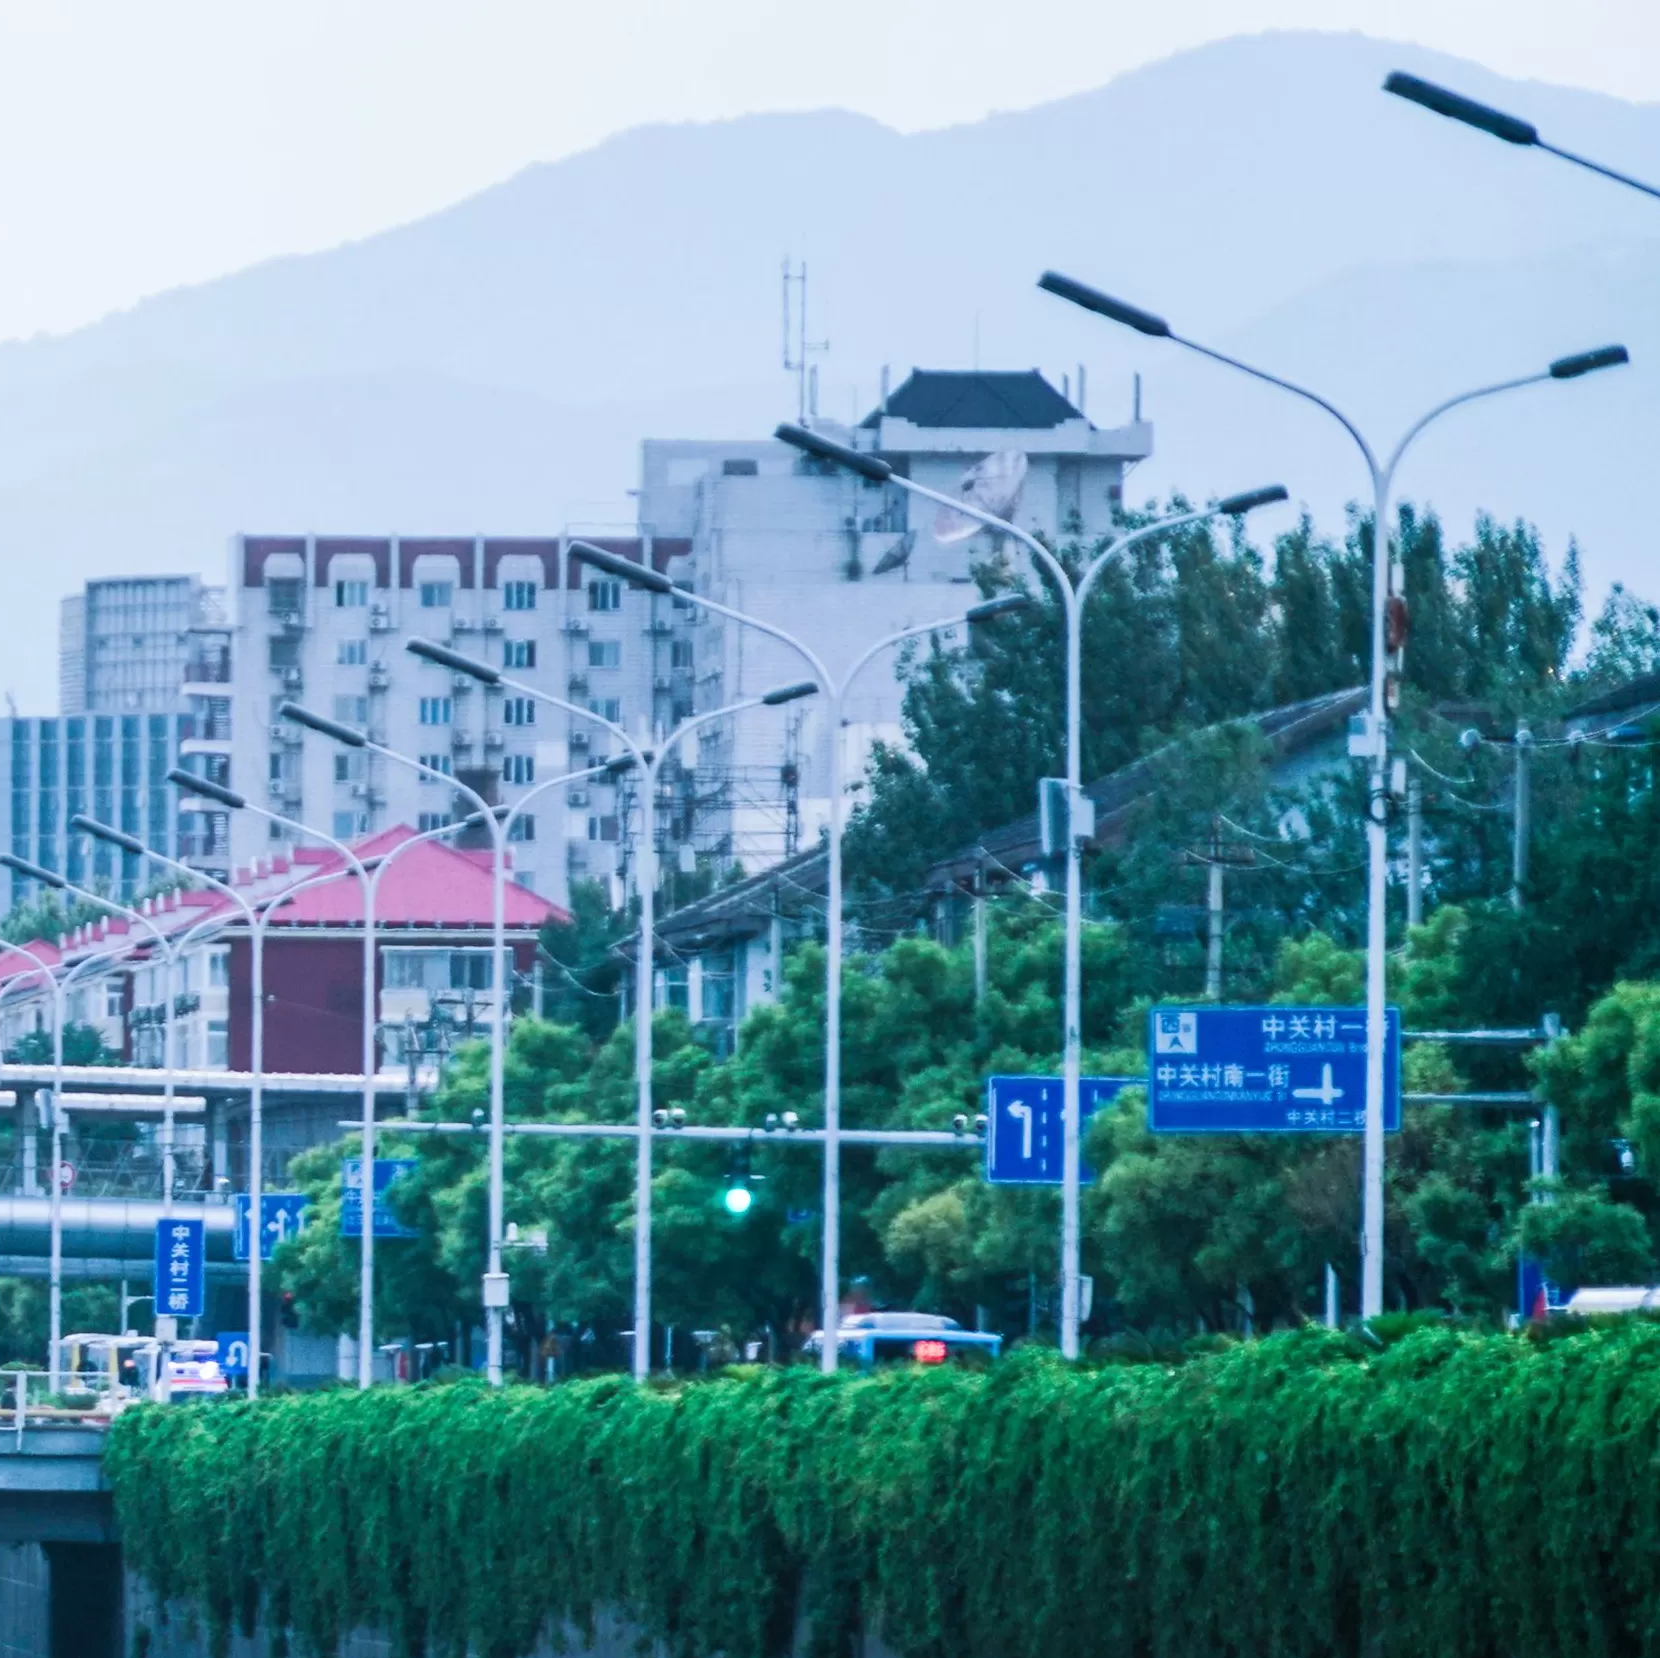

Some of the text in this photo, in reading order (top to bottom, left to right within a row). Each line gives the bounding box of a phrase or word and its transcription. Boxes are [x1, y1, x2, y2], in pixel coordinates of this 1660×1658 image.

[1157, 1062, 1291, 1089] 中关村南一街
[168, 1224, 191, 1311] 中关村二桥
